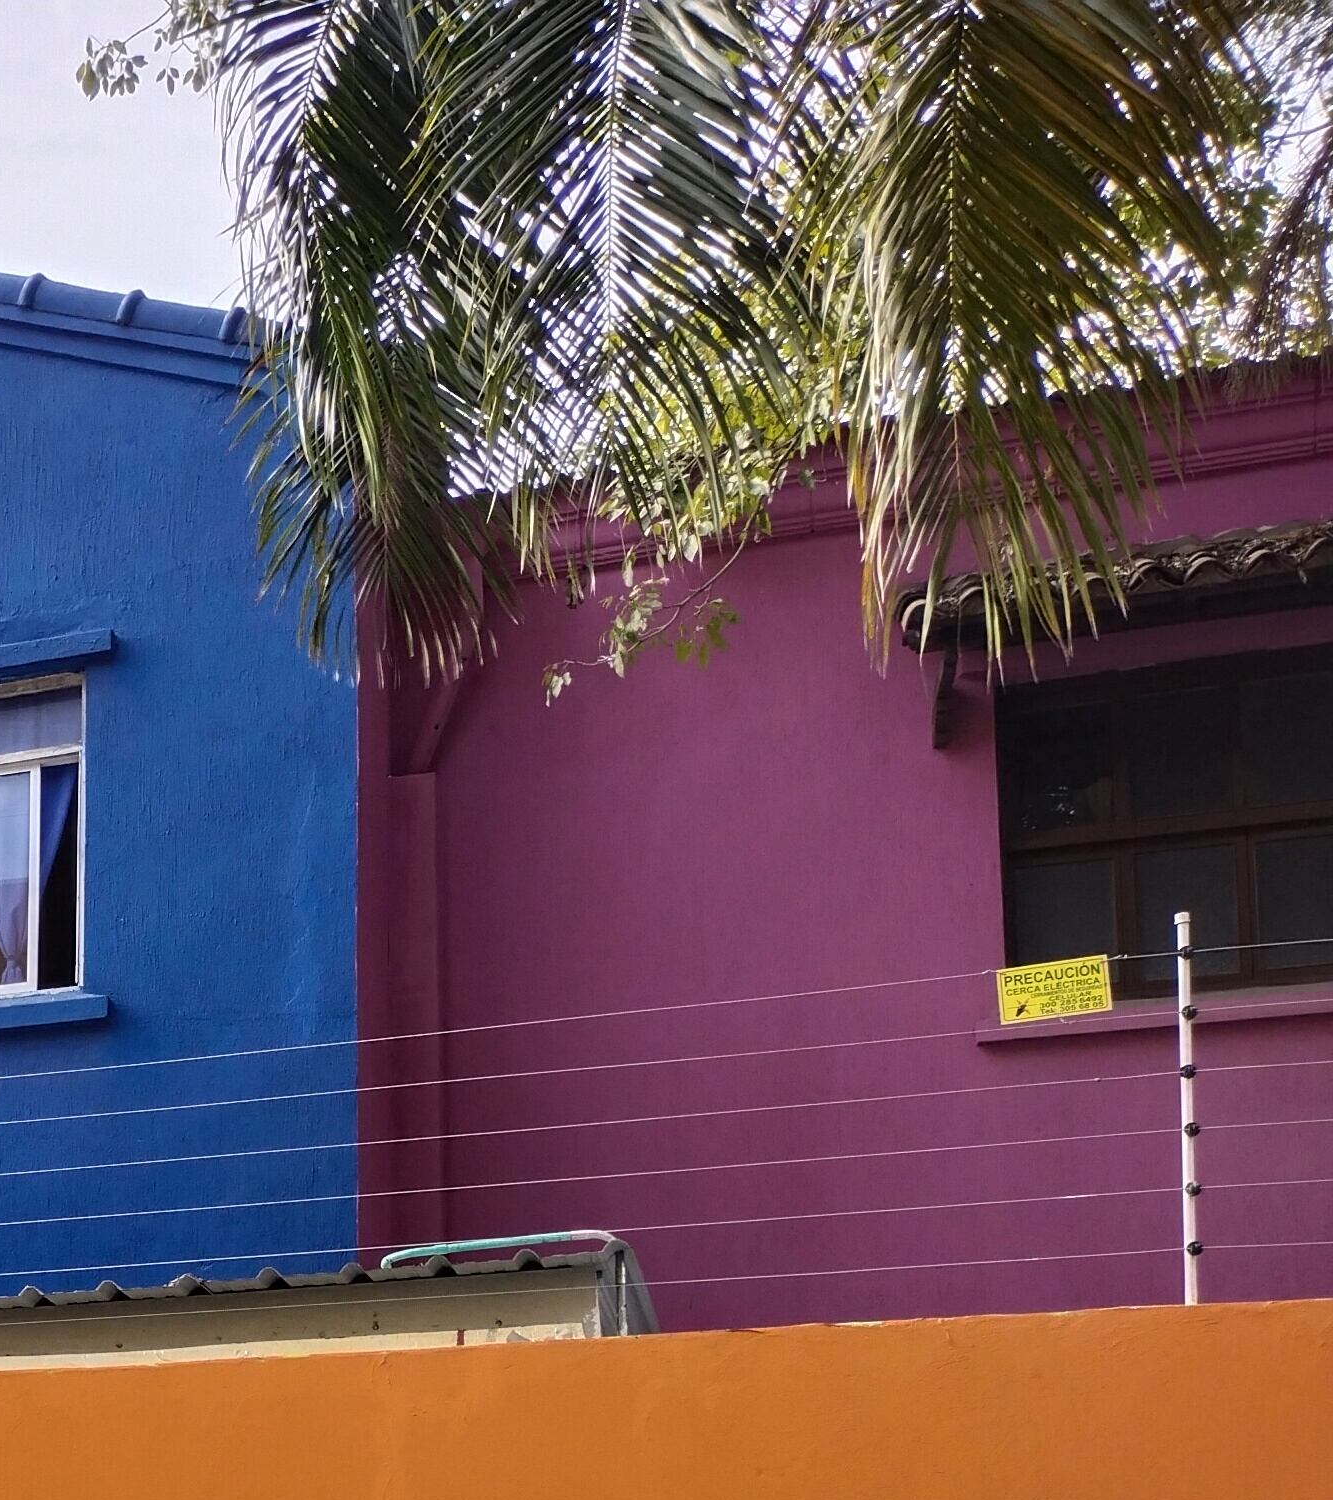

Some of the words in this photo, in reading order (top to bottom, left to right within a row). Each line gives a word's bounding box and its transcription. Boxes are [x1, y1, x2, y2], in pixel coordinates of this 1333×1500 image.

[1004, 963, 1100, 987] PRECAUCIÓN
[1006, 986, 1041, 996] CERCA
[1048, 991, 1092, 1001] CELULAR
